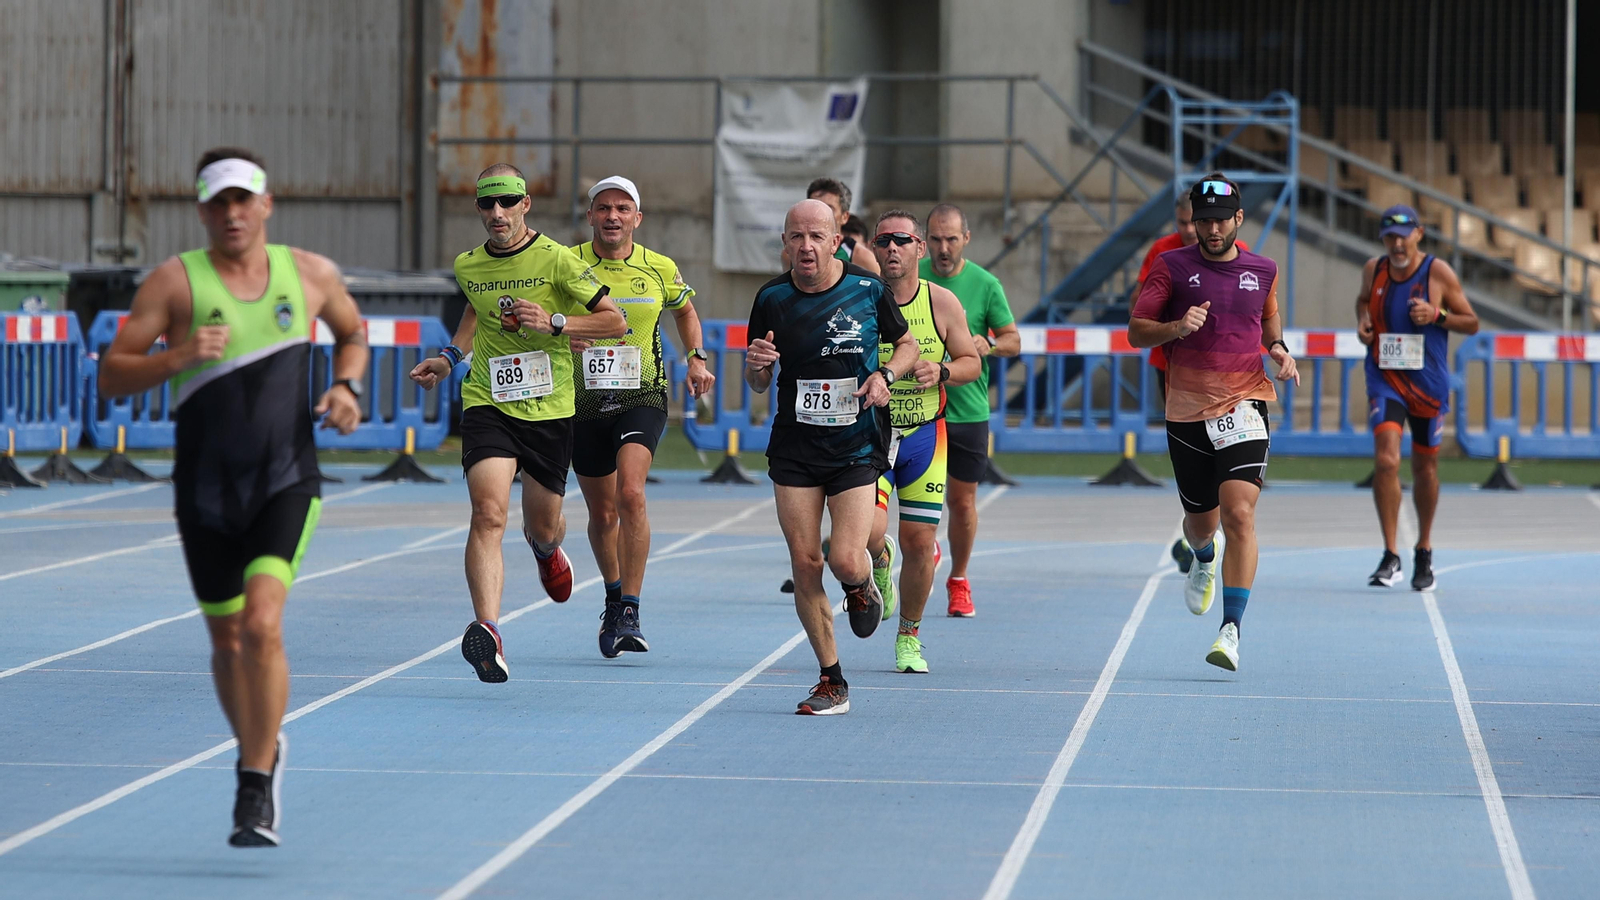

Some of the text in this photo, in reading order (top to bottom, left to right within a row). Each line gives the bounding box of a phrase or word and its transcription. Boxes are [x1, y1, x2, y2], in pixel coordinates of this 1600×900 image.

[467, 276, 545, 295] Paparunners
[820, 346, 831, 356] El
[588, 358, 615, 374] 657
[496, 367, 523, 386] 689
[803, 392, 831, 410] 878
[1217, 416, 1235, 432] 68
